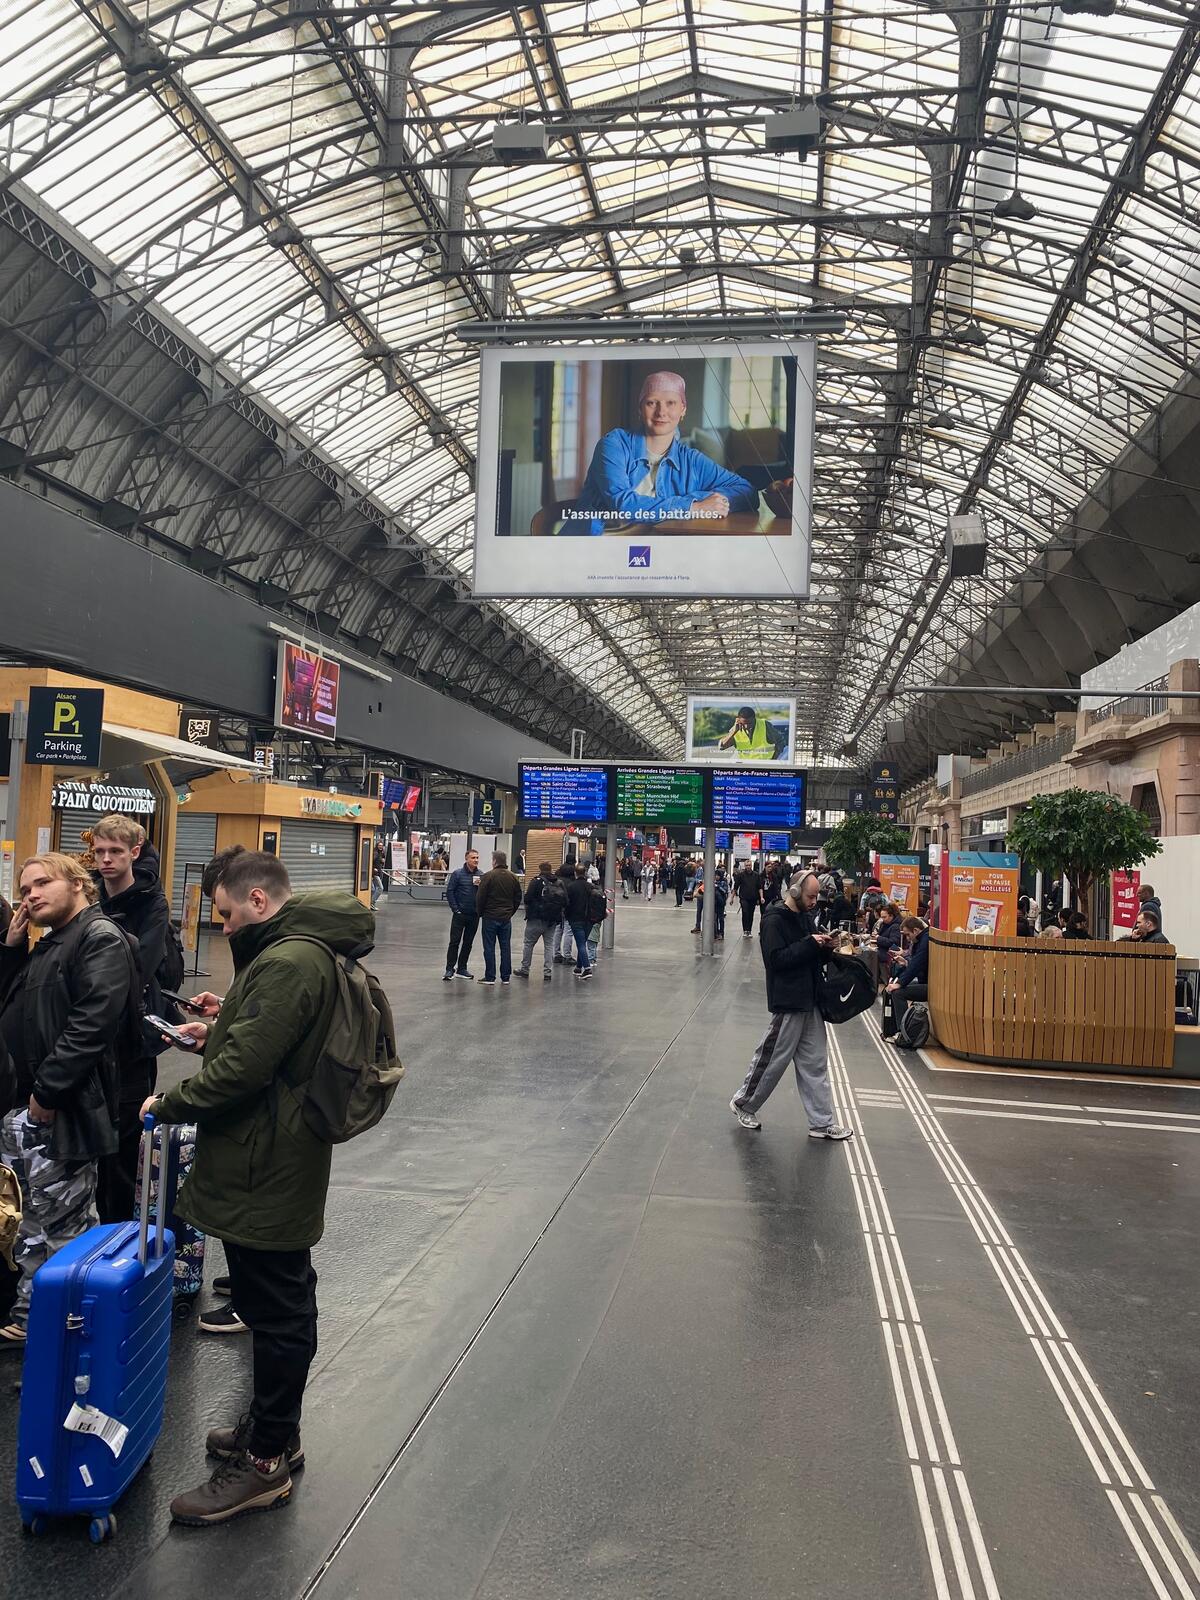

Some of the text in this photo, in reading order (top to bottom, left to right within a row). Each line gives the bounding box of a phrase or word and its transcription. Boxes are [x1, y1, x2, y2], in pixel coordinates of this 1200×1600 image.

[562, 509, 722, 520] L'assurance des battantes.
[628, 556, 647, 565] AXA
[44, 740, 81, 753] Parking
[58, 791, 91, 808] PAIN
[92, 795, 156, 813] QUOTIDIEN
